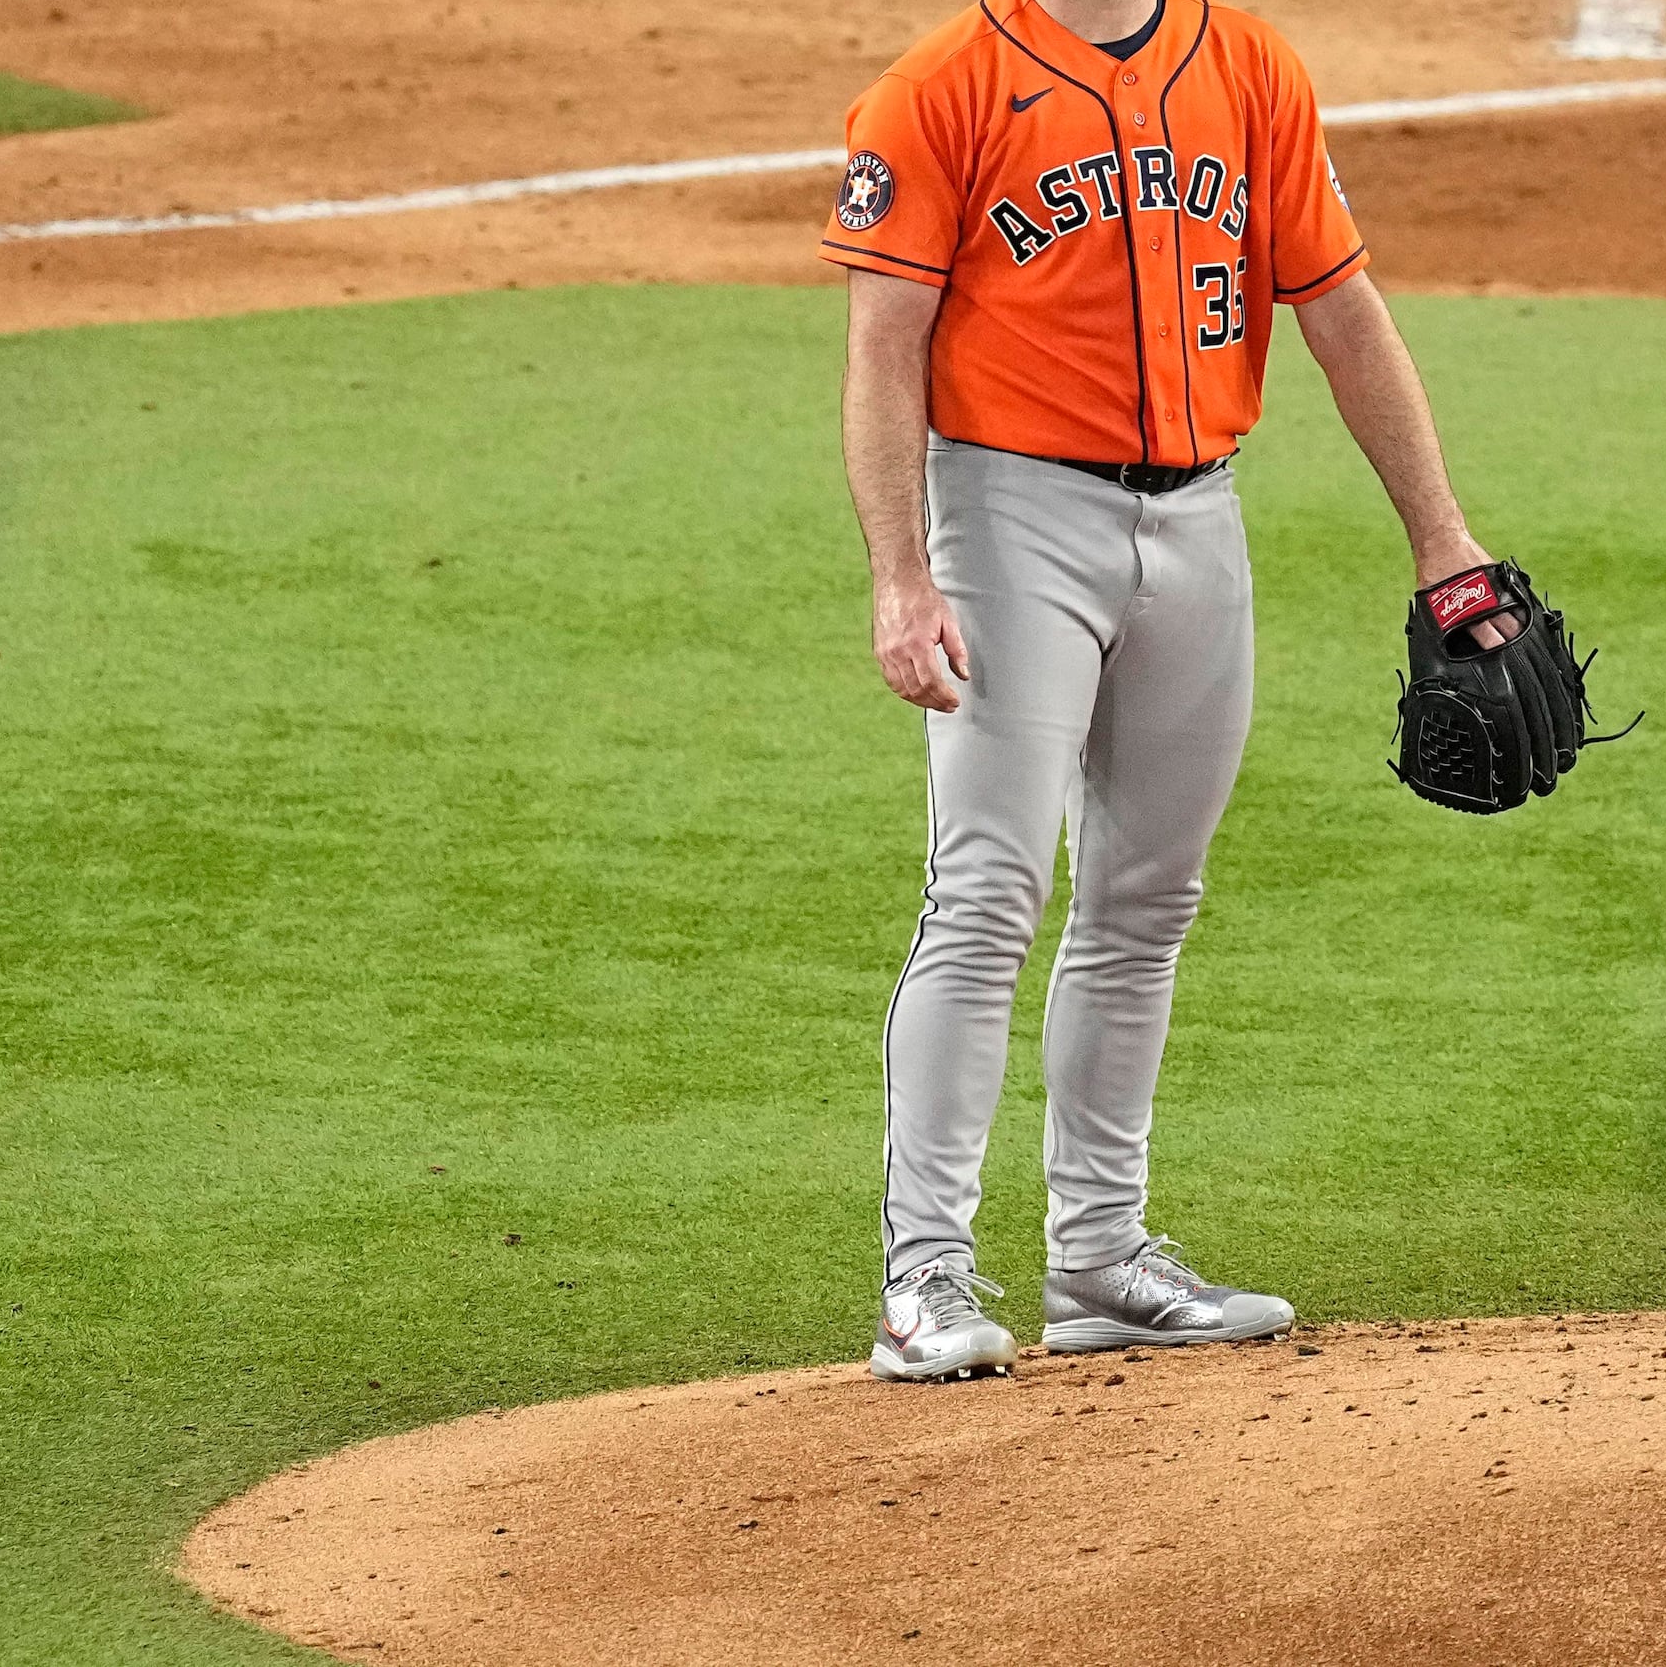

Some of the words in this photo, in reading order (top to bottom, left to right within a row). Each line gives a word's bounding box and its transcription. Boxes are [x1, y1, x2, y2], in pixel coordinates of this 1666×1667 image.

[848, 155, 889, 184] HOUSTON
[839, 205, 874, 227] ASTROS
[987, 145, 1248, 267] ASTROS
[1192, 256, 1247, 351] 35
[1440, 583, 1486, 617] Rawlings
